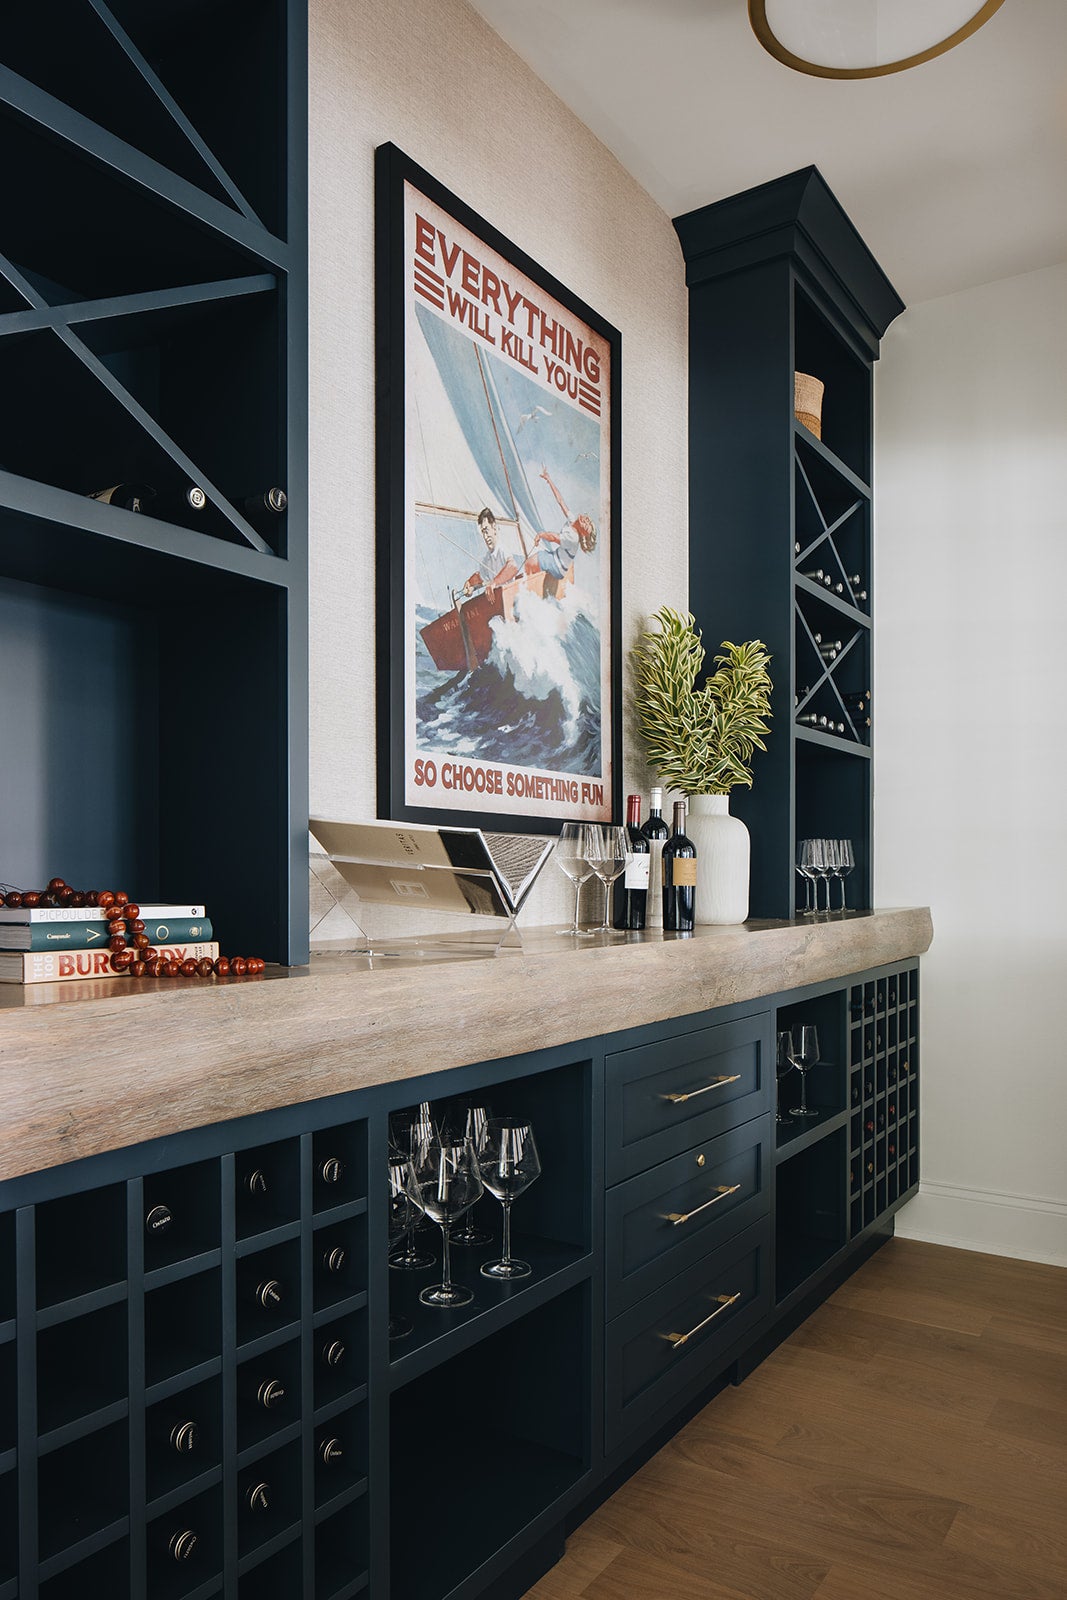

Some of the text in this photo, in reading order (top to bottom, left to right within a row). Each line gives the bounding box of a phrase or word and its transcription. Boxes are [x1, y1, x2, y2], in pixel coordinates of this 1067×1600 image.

[415, 212, 600, 384] EVERYTHING
[446, 284, 578, 400] WILL KILL YOU
[414, 758, 604, 806] SO CHOOSE SOMETHING FUN
[39, 909, 82, 920] PICPOUL
[59, 947, 187, 977] BURDY
